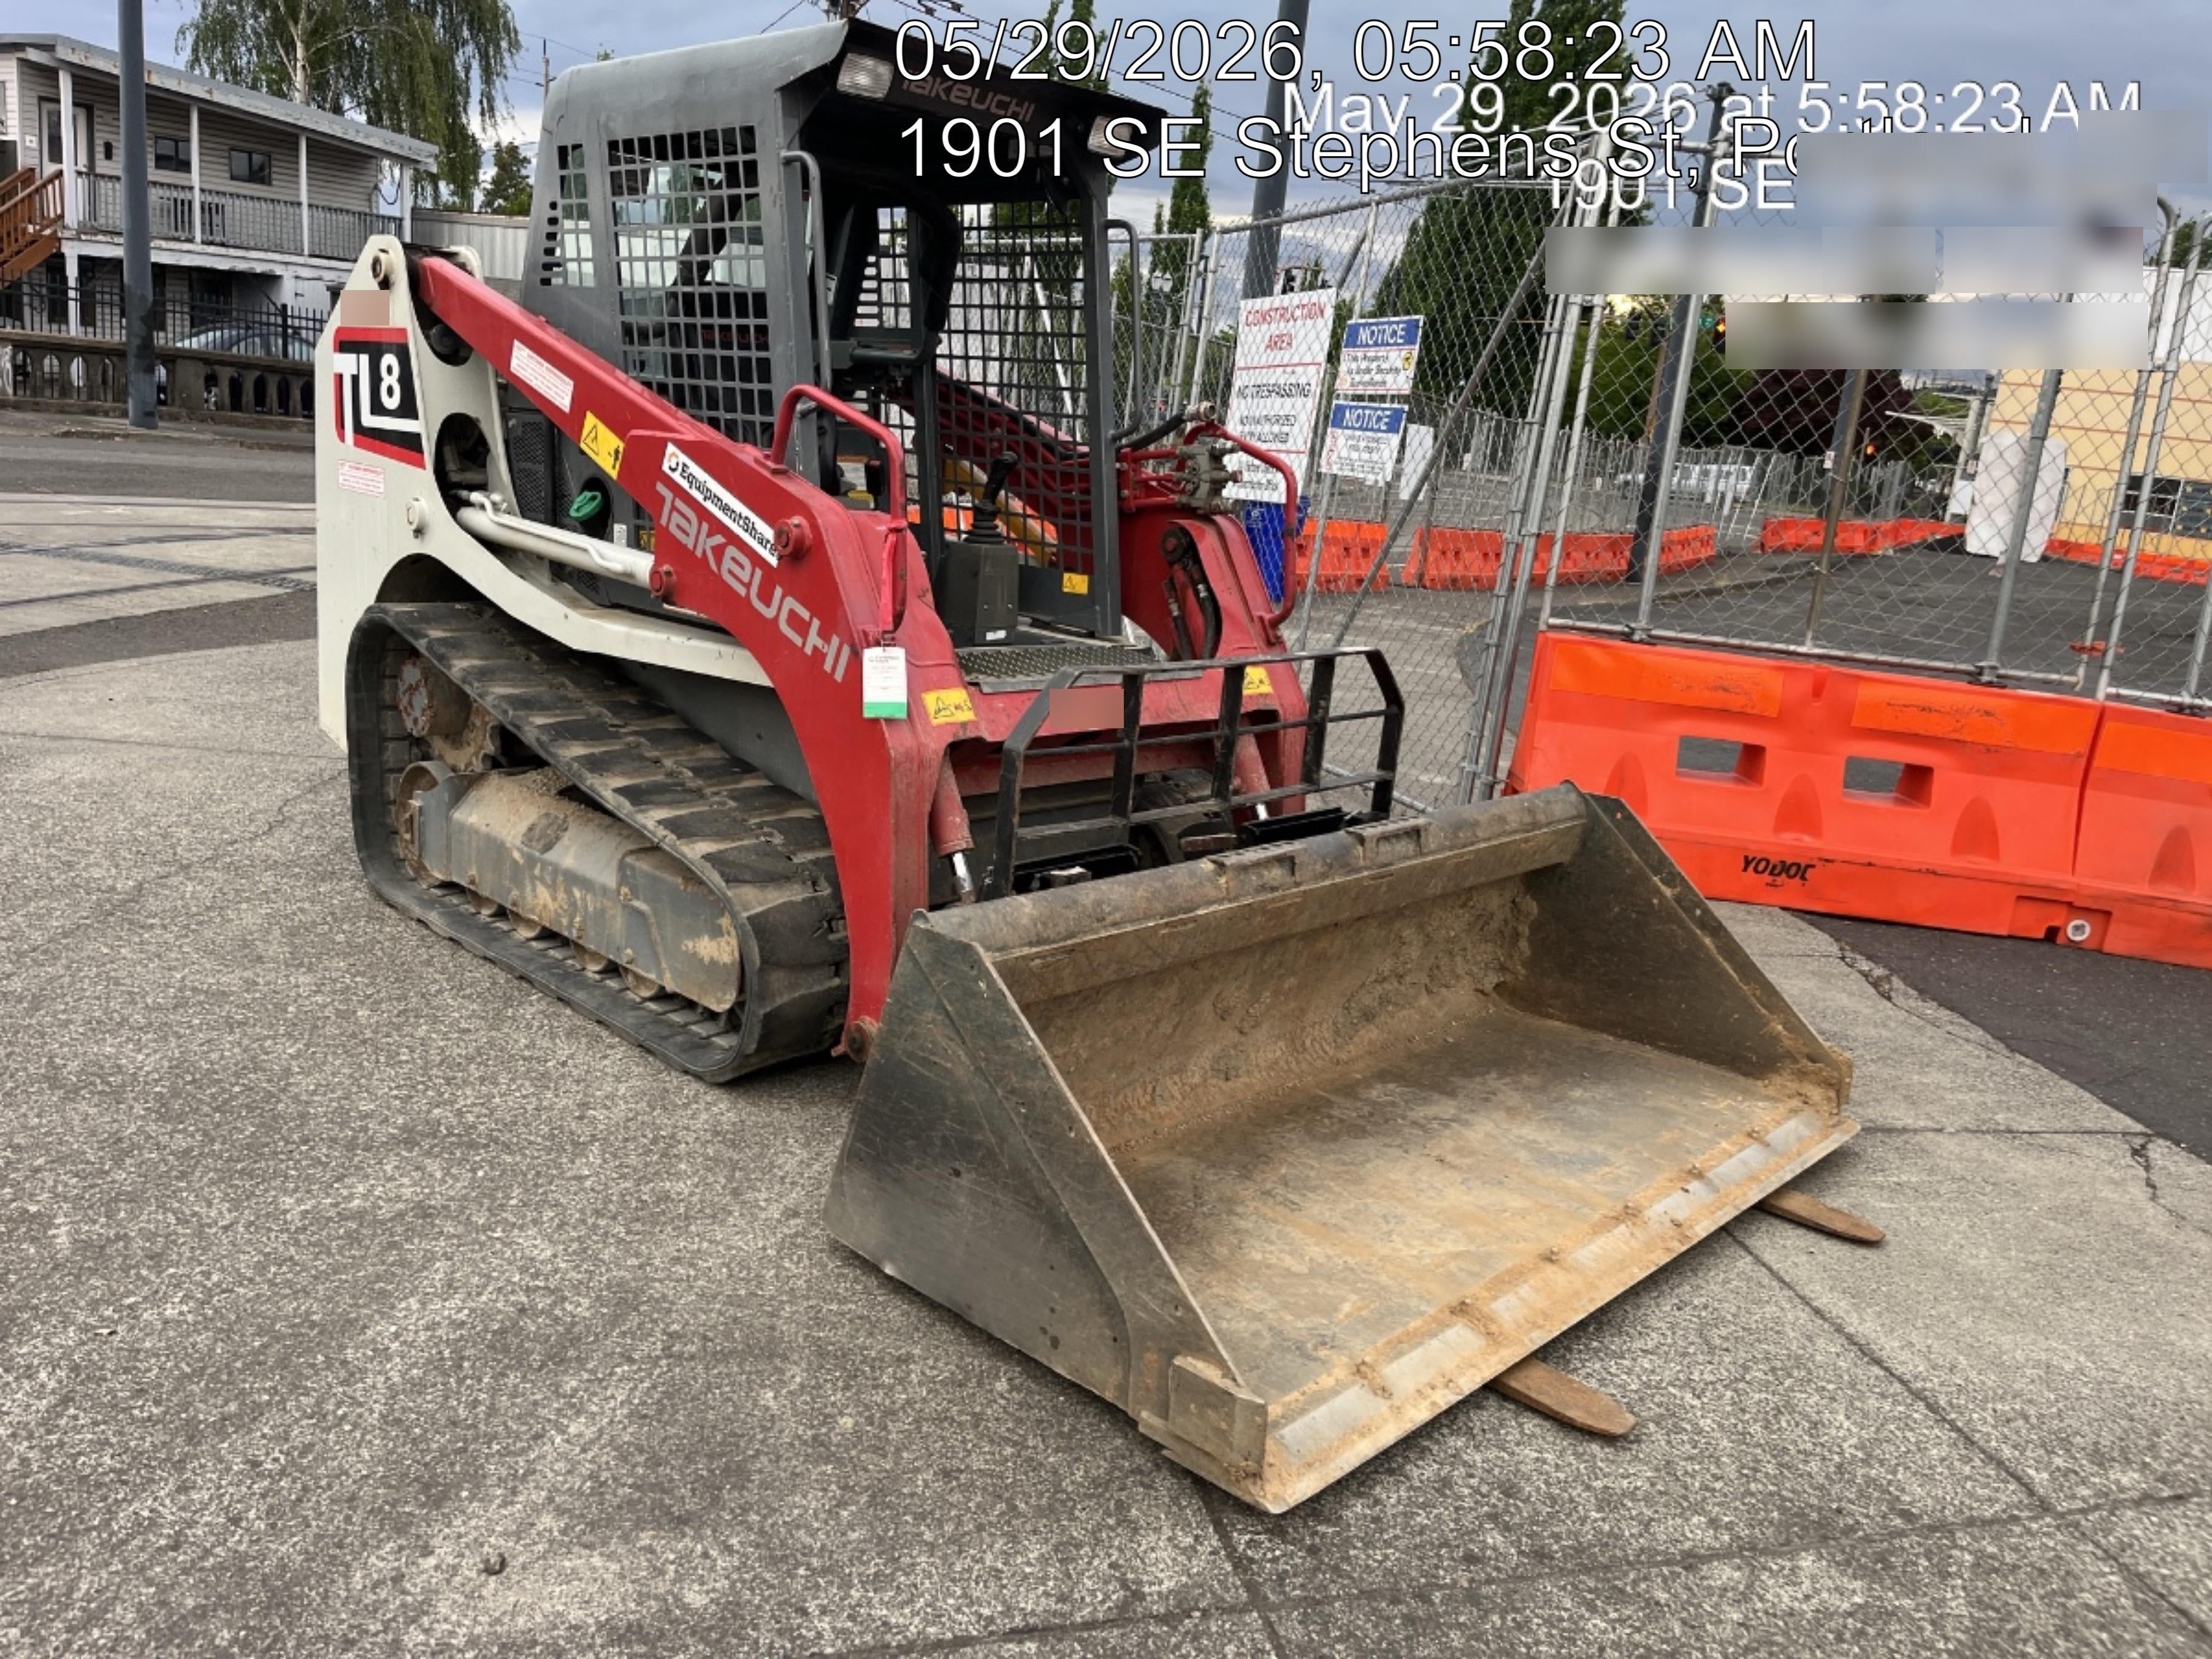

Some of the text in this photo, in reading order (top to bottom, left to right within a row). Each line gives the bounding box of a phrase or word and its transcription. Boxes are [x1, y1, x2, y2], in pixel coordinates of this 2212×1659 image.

[1245, 302, 1325, 327] CONSTRUCTION
[1265, 332, 1293, 352] AREA
[1357, 323, 1407, 345] NOTICE
[1251, 382, 1311, 399] TRESPASSING
[1343, 407, 1392, 430] NOTICE
[679, 461, 777, 557] EquipmentShare
